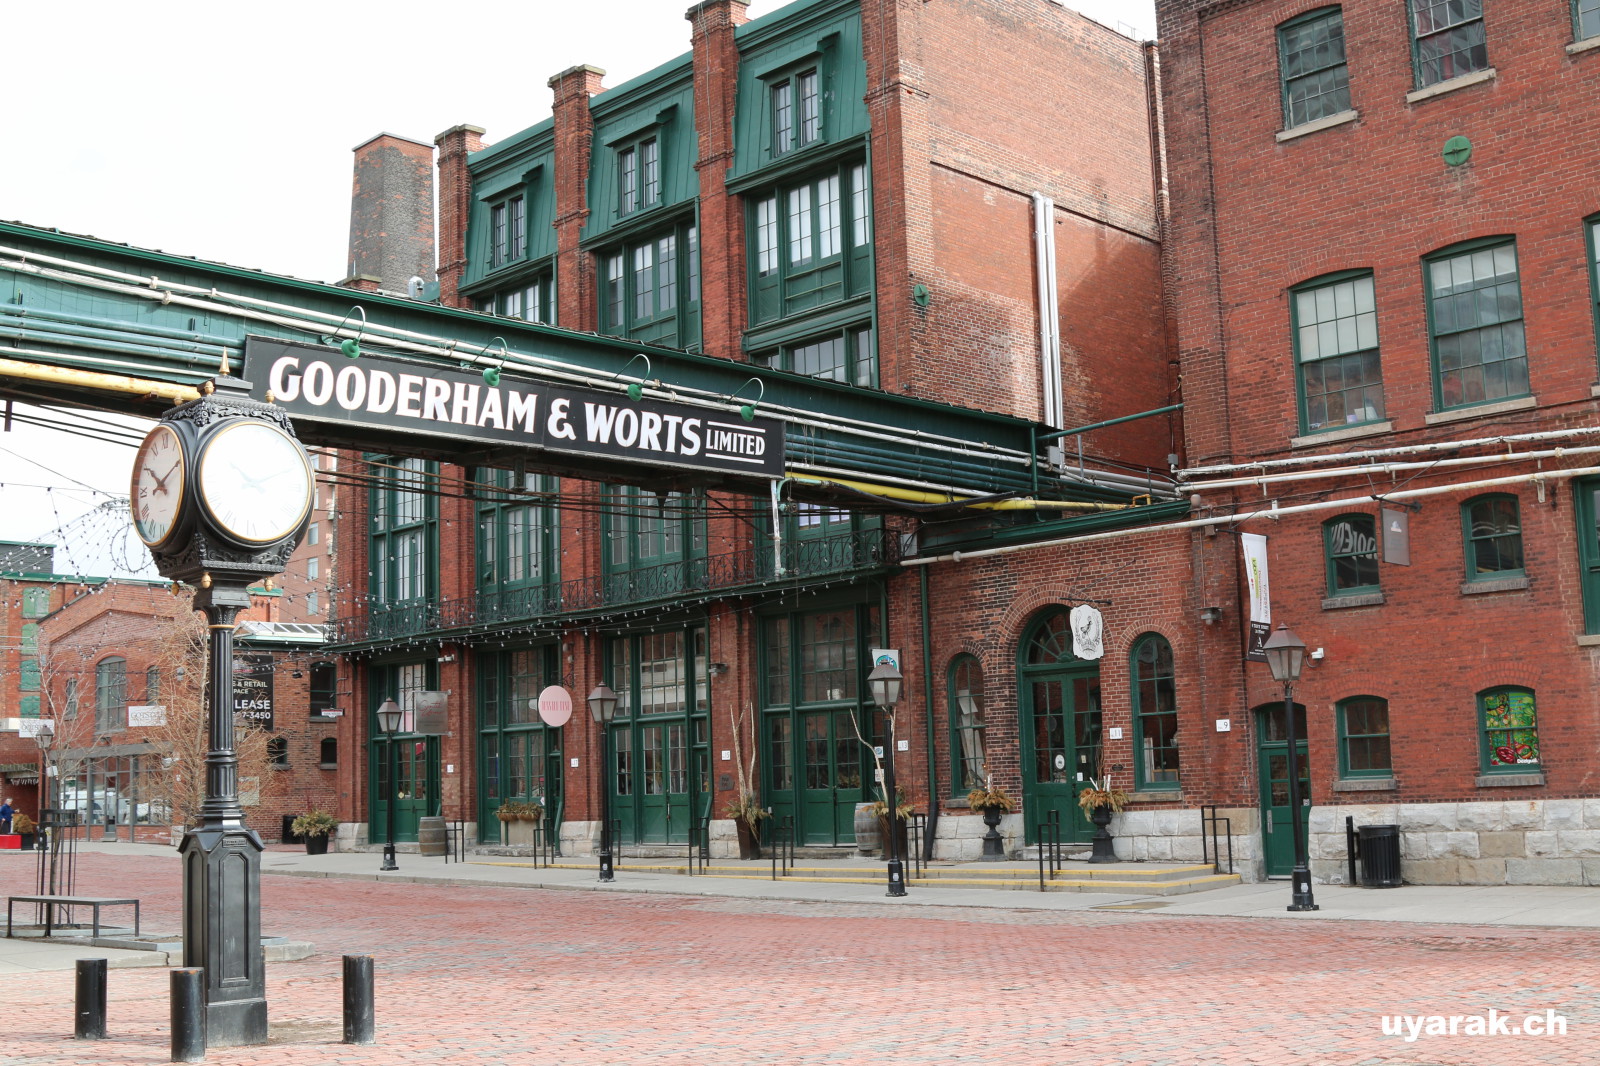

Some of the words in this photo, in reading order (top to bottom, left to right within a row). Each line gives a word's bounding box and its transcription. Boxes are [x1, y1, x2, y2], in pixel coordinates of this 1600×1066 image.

[268, 356, 538, 434] GOODERHAM
[547, 398, 576, 441] &
[583, 403, 702, 456] WORTS
[705, 427, 766, 456] LIMITED
[234, 699, 271, 709] LEASE
[232, 711, 271, 719] 7-3450
